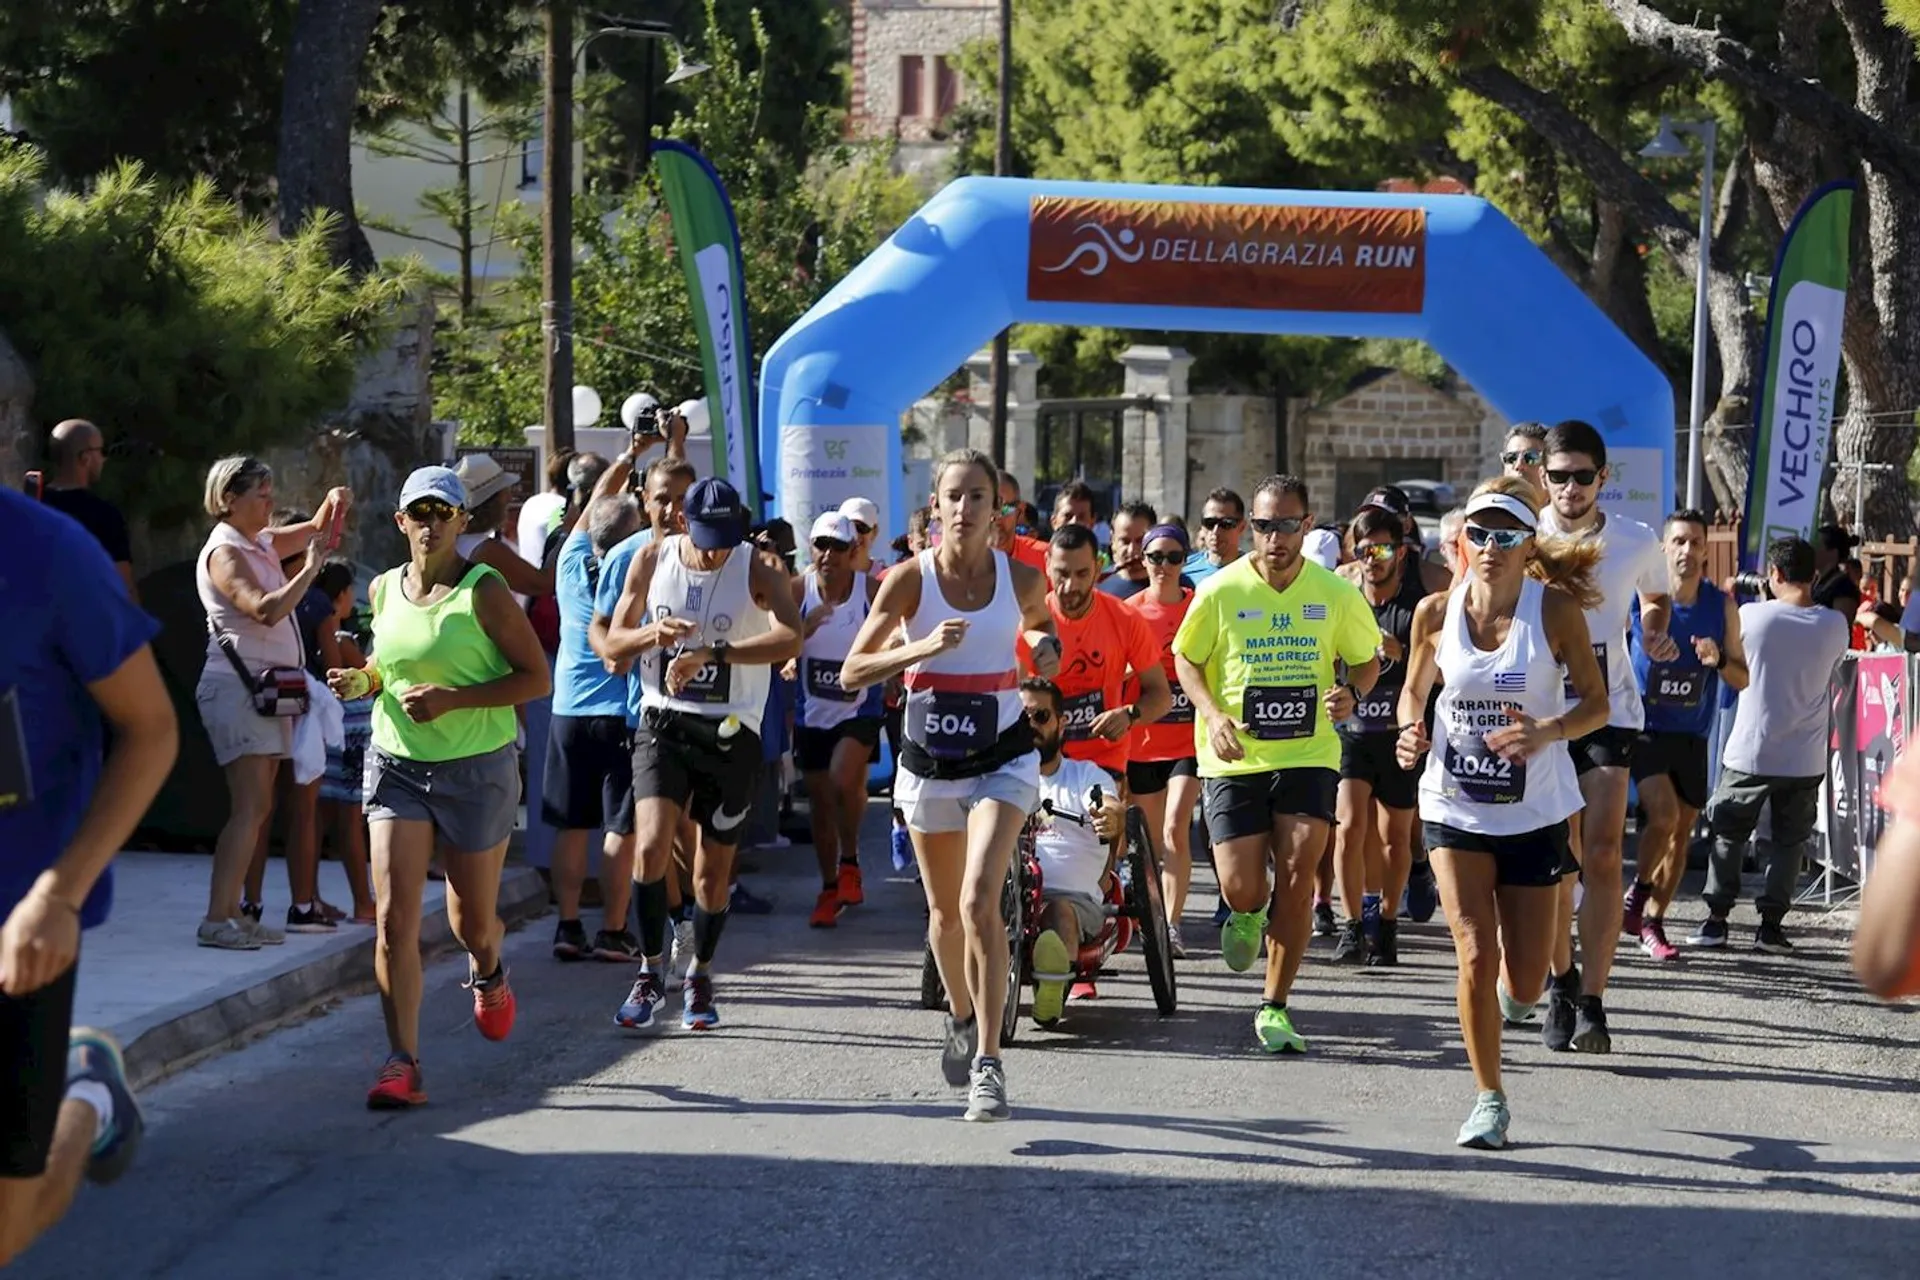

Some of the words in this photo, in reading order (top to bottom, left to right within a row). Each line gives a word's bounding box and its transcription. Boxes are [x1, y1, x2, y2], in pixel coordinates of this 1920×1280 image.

[1151, 237, 1344, 267] DELLAGRAZIA
[1355, 244, 1416, 268] RUN
[1777, 319, 1817, 508] VECHRO
[1814, 377, 1831, 464] PAINTS
[790, 467, 848, 479] Printezis
[852, 465, 884, 478] Store
[1245, 635, 1318, 649] MARATHON
[1240, 653, 1273, 664] TEAM
[693, 664, 719, 683] 07
[814, 669, 842, 685] 102
[1660, 680, 1692, 695] 510
[1063, 704, 1096, 725] 028
[1254, 701, 1307, 719] 1023
[1358, 701, 1392, 718] 502
[924, 712, 977, 737] 504
[1452, 755, 1511, 778] 1042
